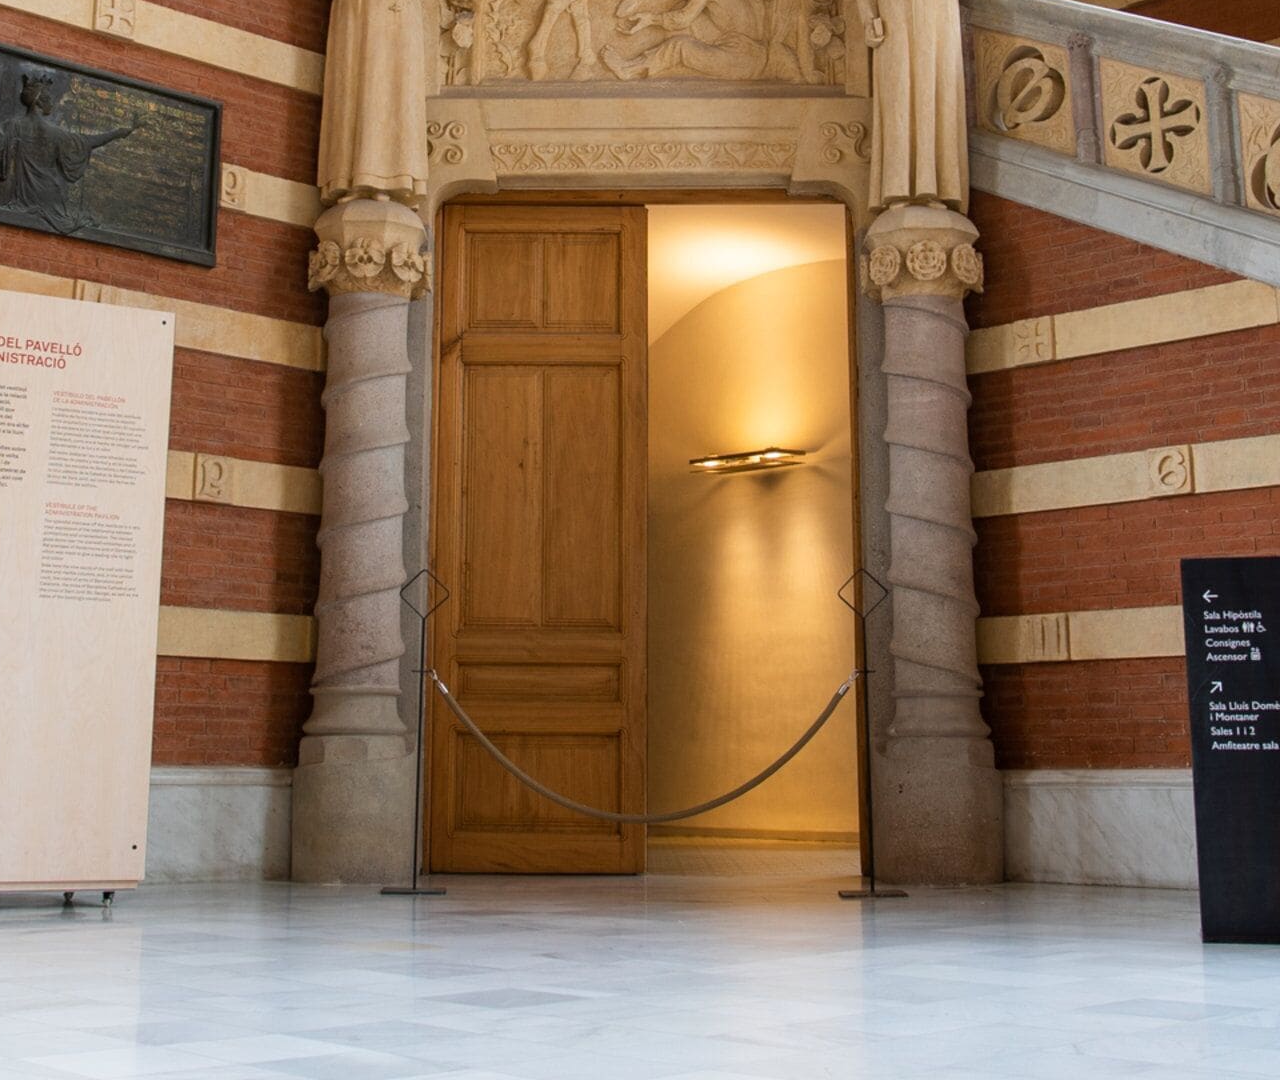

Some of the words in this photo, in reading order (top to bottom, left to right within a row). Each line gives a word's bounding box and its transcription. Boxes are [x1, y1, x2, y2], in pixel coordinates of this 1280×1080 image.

[25, 338, 82, 357] PAVELLÓ
[1203, 610, 1221, 619] Sala
[1222, 610, 1262, 621] Hipòstila
[1204, 624, 1239, 633] Lavabos
[1205, 638, 1251, 649] Consignes
[1206, 652, 1248, 661] Ascensor
[1209, 701, 1226, 710] Sala
[1215, 712, 1259, 721] Montaner
[1210, 726, 1233, 735] Sales
[1249, 726, 1256, 735] 2
[1211, 741, 1260, 750] Amfiteatre
[1262, 741, 1279, 750] sala
